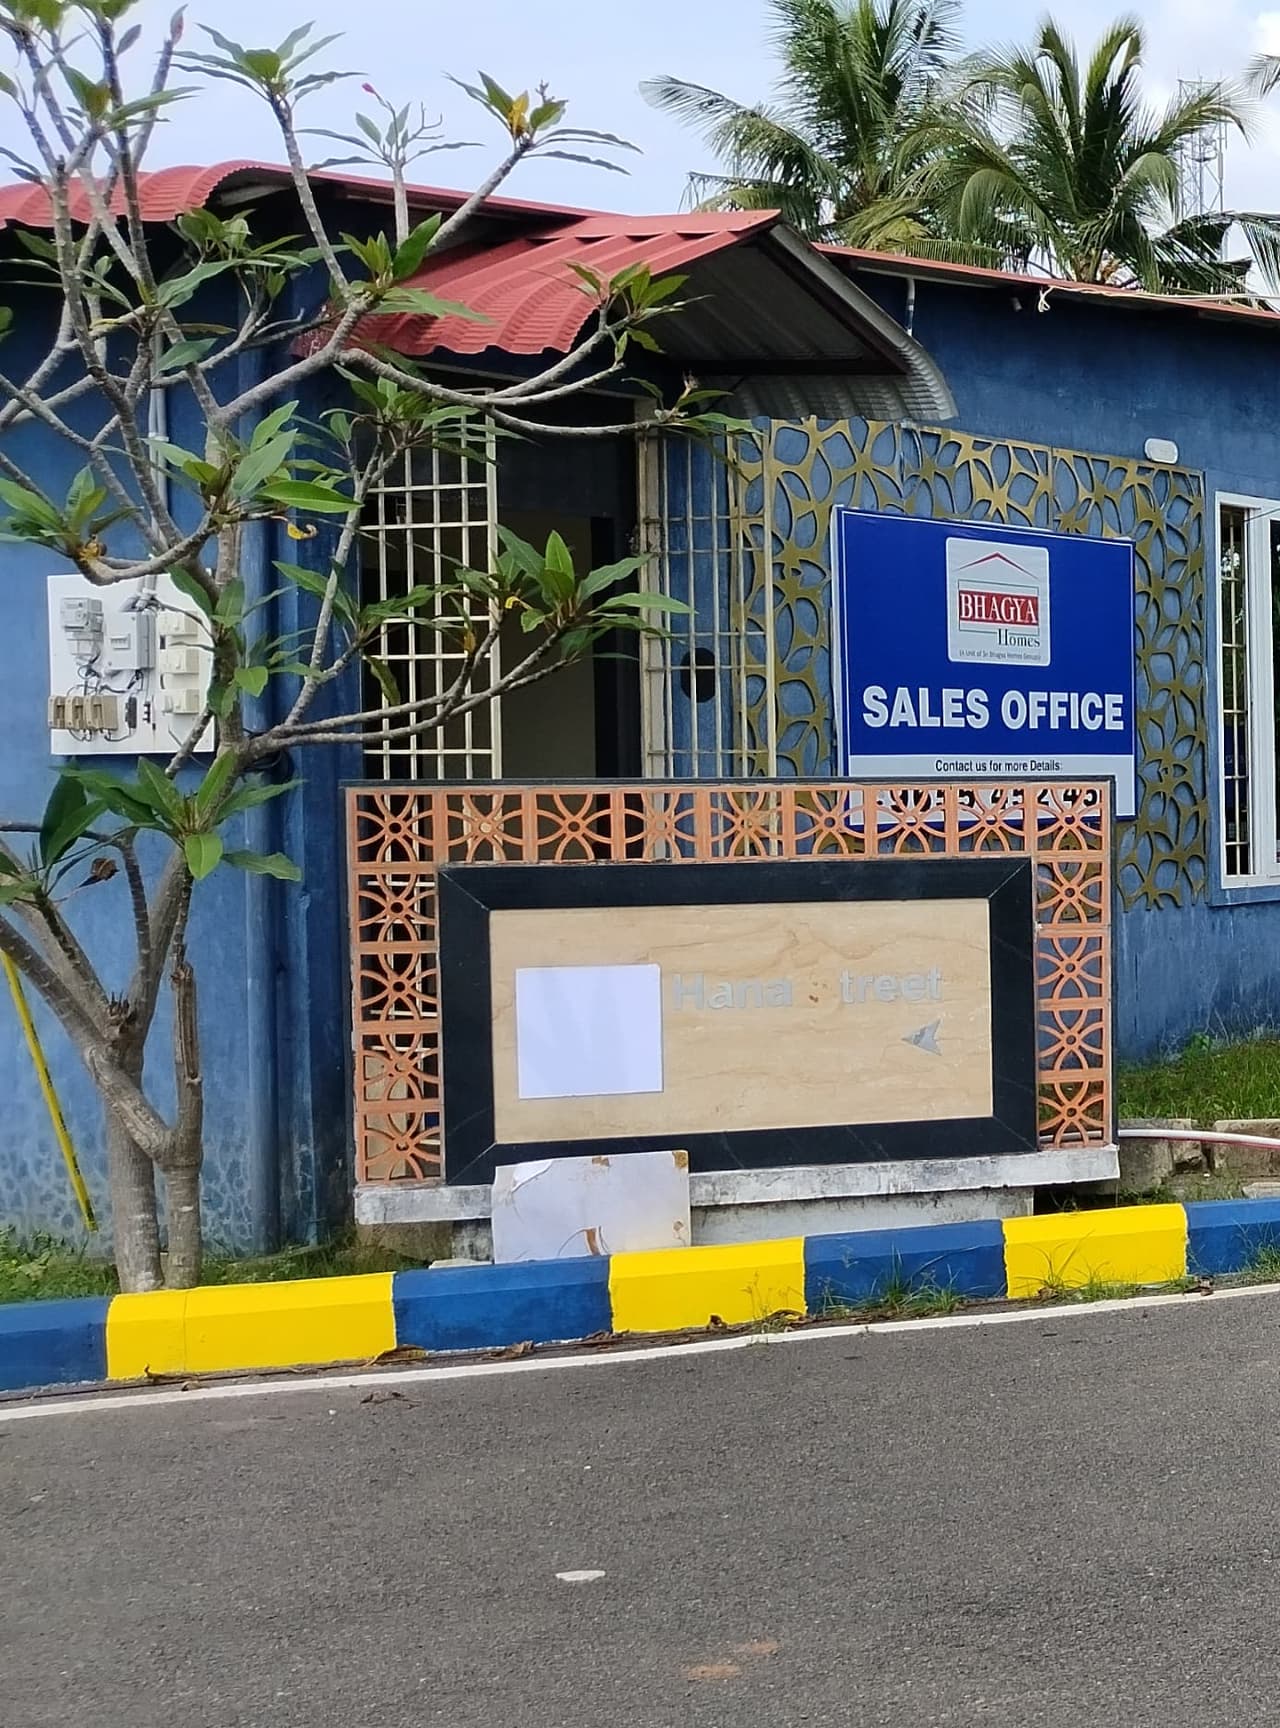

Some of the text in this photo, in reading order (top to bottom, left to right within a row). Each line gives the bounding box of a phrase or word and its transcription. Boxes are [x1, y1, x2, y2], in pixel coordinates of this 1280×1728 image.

[959, 593, 1038, 624] BHAGYA
[997, 628, 1040, 648] Homes
[863, 685, 1124, 730] SALES OFFICE
[935, 760, 973, 772] Contact
[975, 762, 987, 772] us
[989, 760, 1002, 772] for
[1005, 762, 1028, 772] more
[674, 973, 793, 1009] Hana
